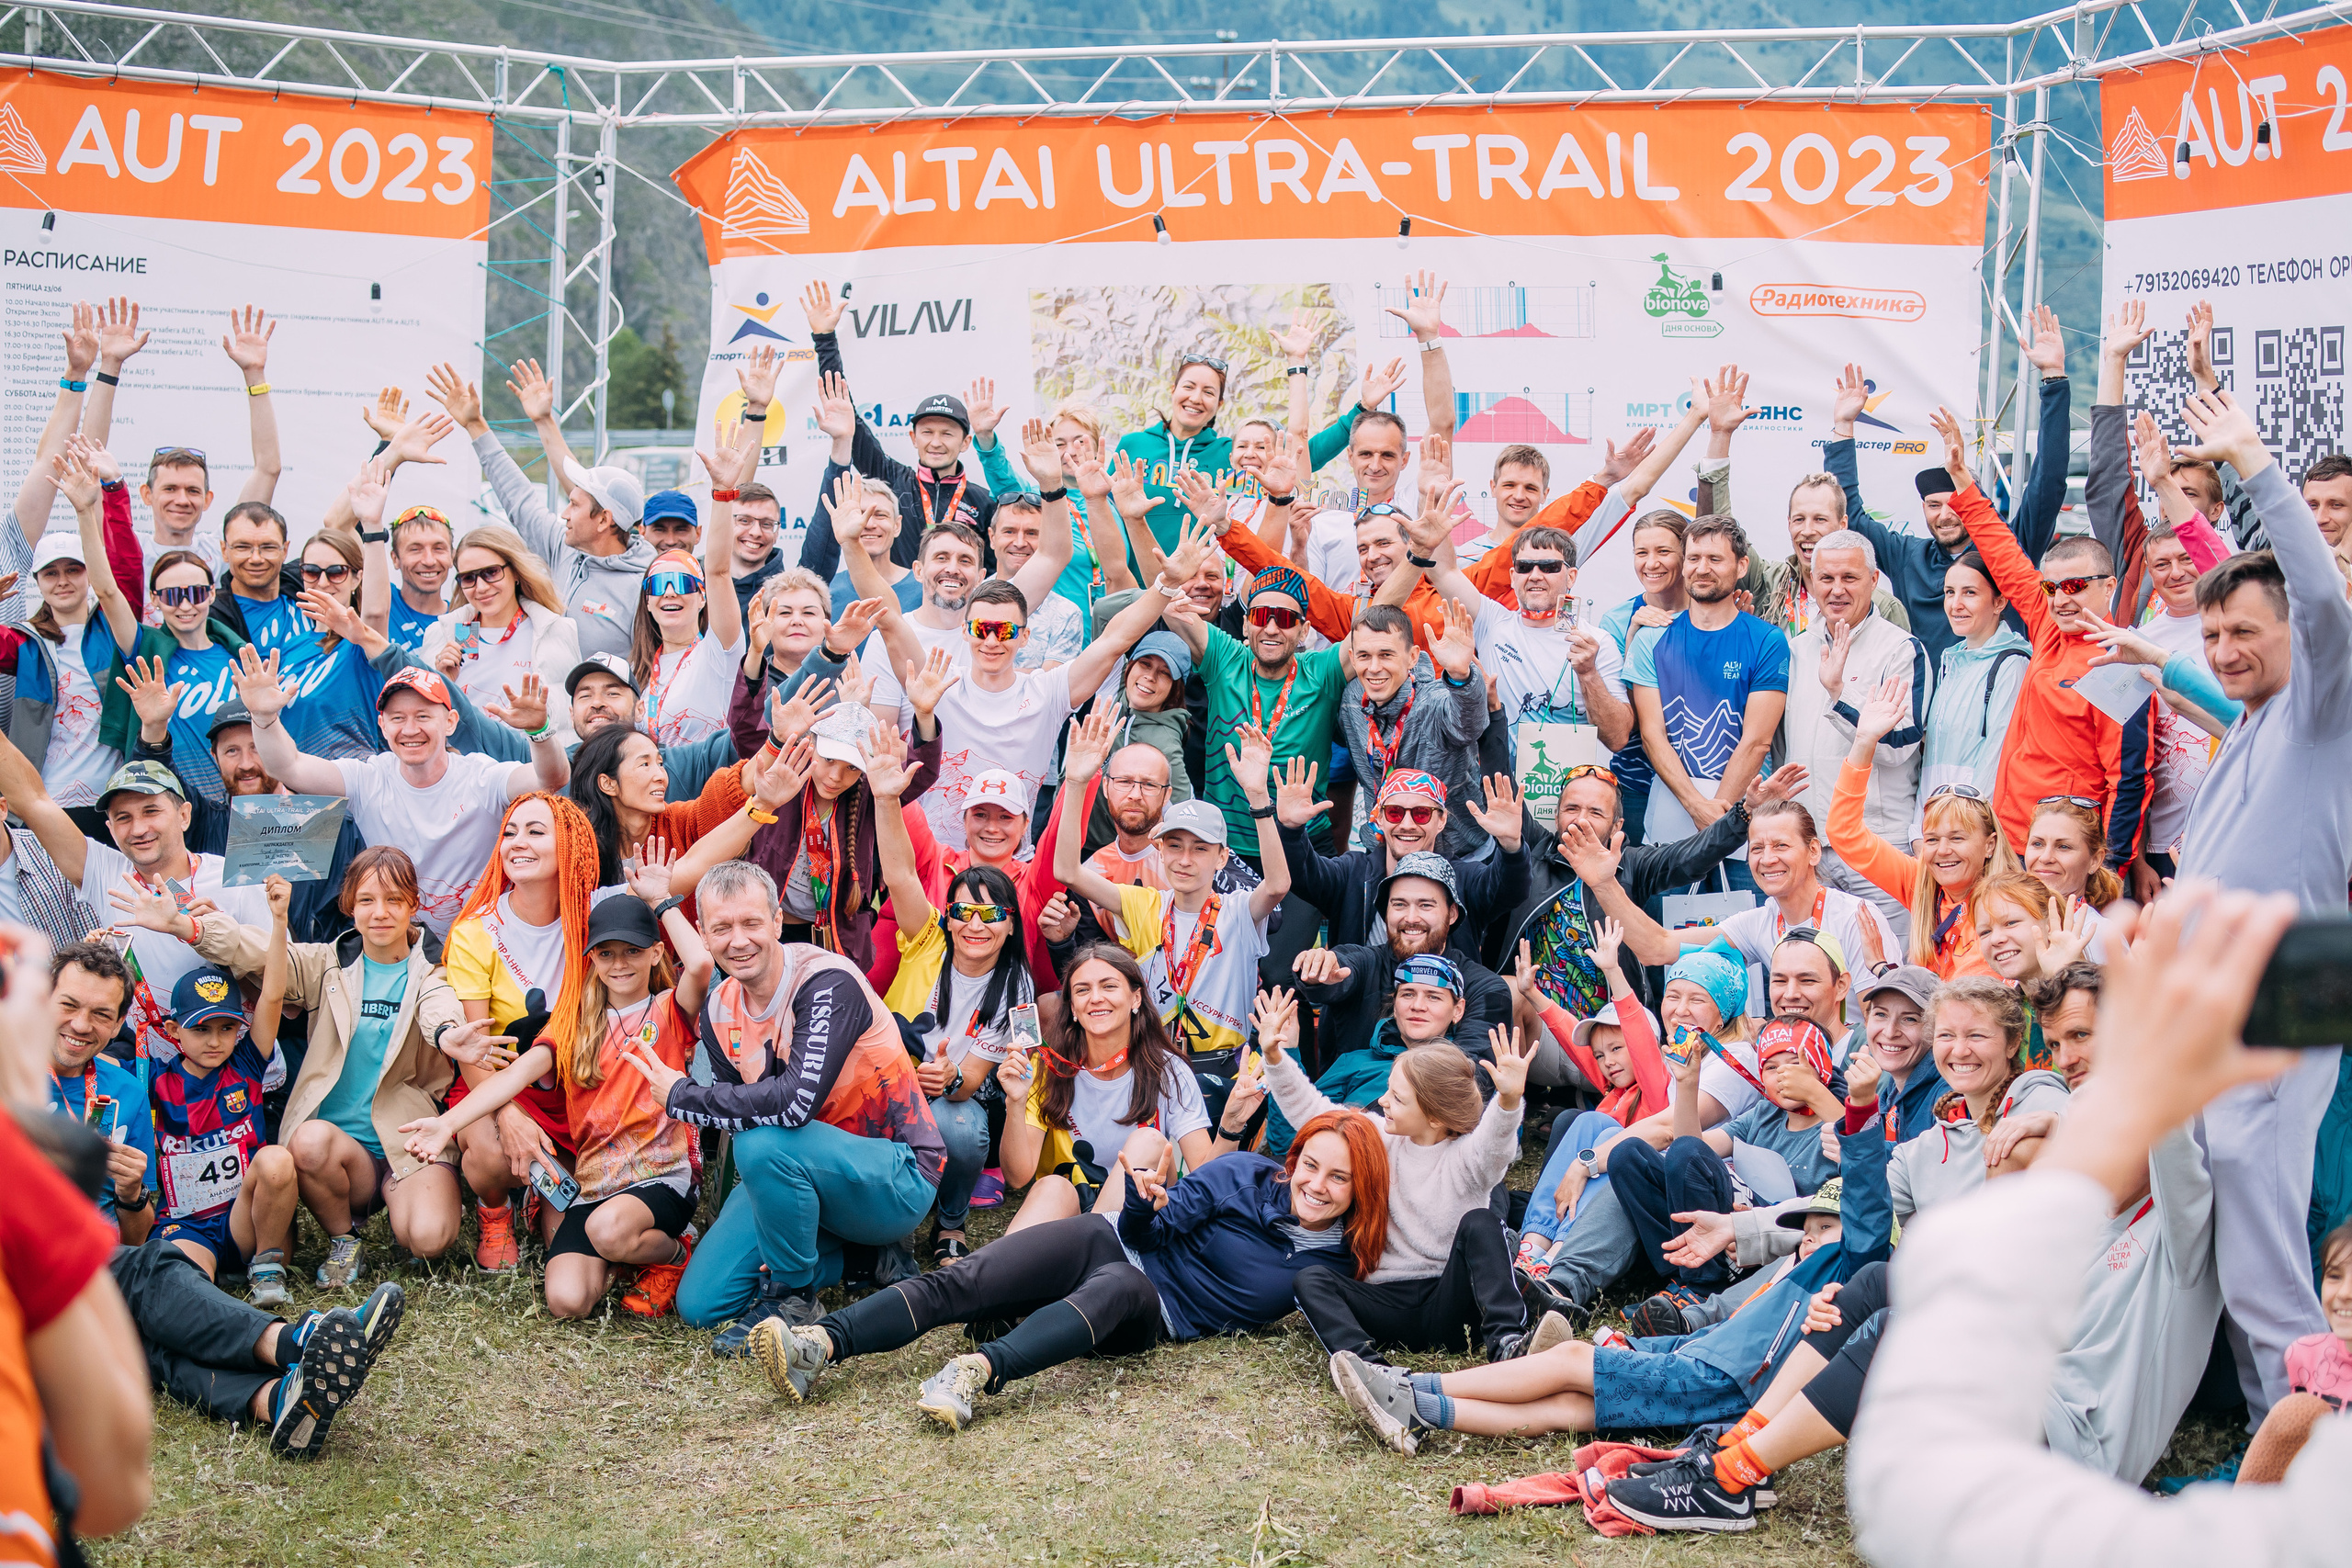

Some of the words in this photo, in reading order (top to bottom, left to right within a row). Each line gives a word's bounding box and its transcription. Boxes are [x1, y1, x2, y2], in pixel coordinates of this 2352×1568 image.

[2174, 74, 2287, 168] AUT
[57, 104, 243, 186] AUT
[277, 123, 476, 206] 2023
[831, 143, 1056, 220] ALTAI
[1096, 131, 1679, 209] ULTRA-TRAIL
[1724, 132, 1953, 208] 2023
[5, 249, 147, 274] РАСПИСАНИЕ
[2124, 266, 2240, 294] +79132069420
[2247, 257, 2323, 285] ТЕЛЕФОН
[6, 282, 42, 292] ПЯТНИЦА
[1645, 294, 1709, 310] bionova
[1759, 288, 1917, 313] Радиотехника
[6, 308, 38, 317] Открытие
[40, 310, 60, 318] Экспо
[1665, 324, 1682, 333] ДНЯ
[1684, 324, 1717, 333] ОСНОВА
[44, 343, 65, 351] Прове
[787, 350, 814, 360] PRO
[5, 389, 37, 398] СУББОТА
[1626, 402, 1672, 417] МРТ
[1894, 442, 1926, 453] PRO
[1250, 568, 1285, 595] DYNAFIT
[260, 825, 301, 836] ДИПЛОМ
[1410, 966, 1439, 976] MORVÉLO
[197, 975, 223, 985] RUSSIA
[800, 987, 833, 1085] USSURI
[1760, 1028, 1792, 1045] ALTAI
[198, 1155, 240, 1185] 49
[2108, 1240, 2132, 1253] ALTAI
[2107, 1250, 2132, 1263] ULTRA
[2107, 1259, 2129, 1272] TRAIL
